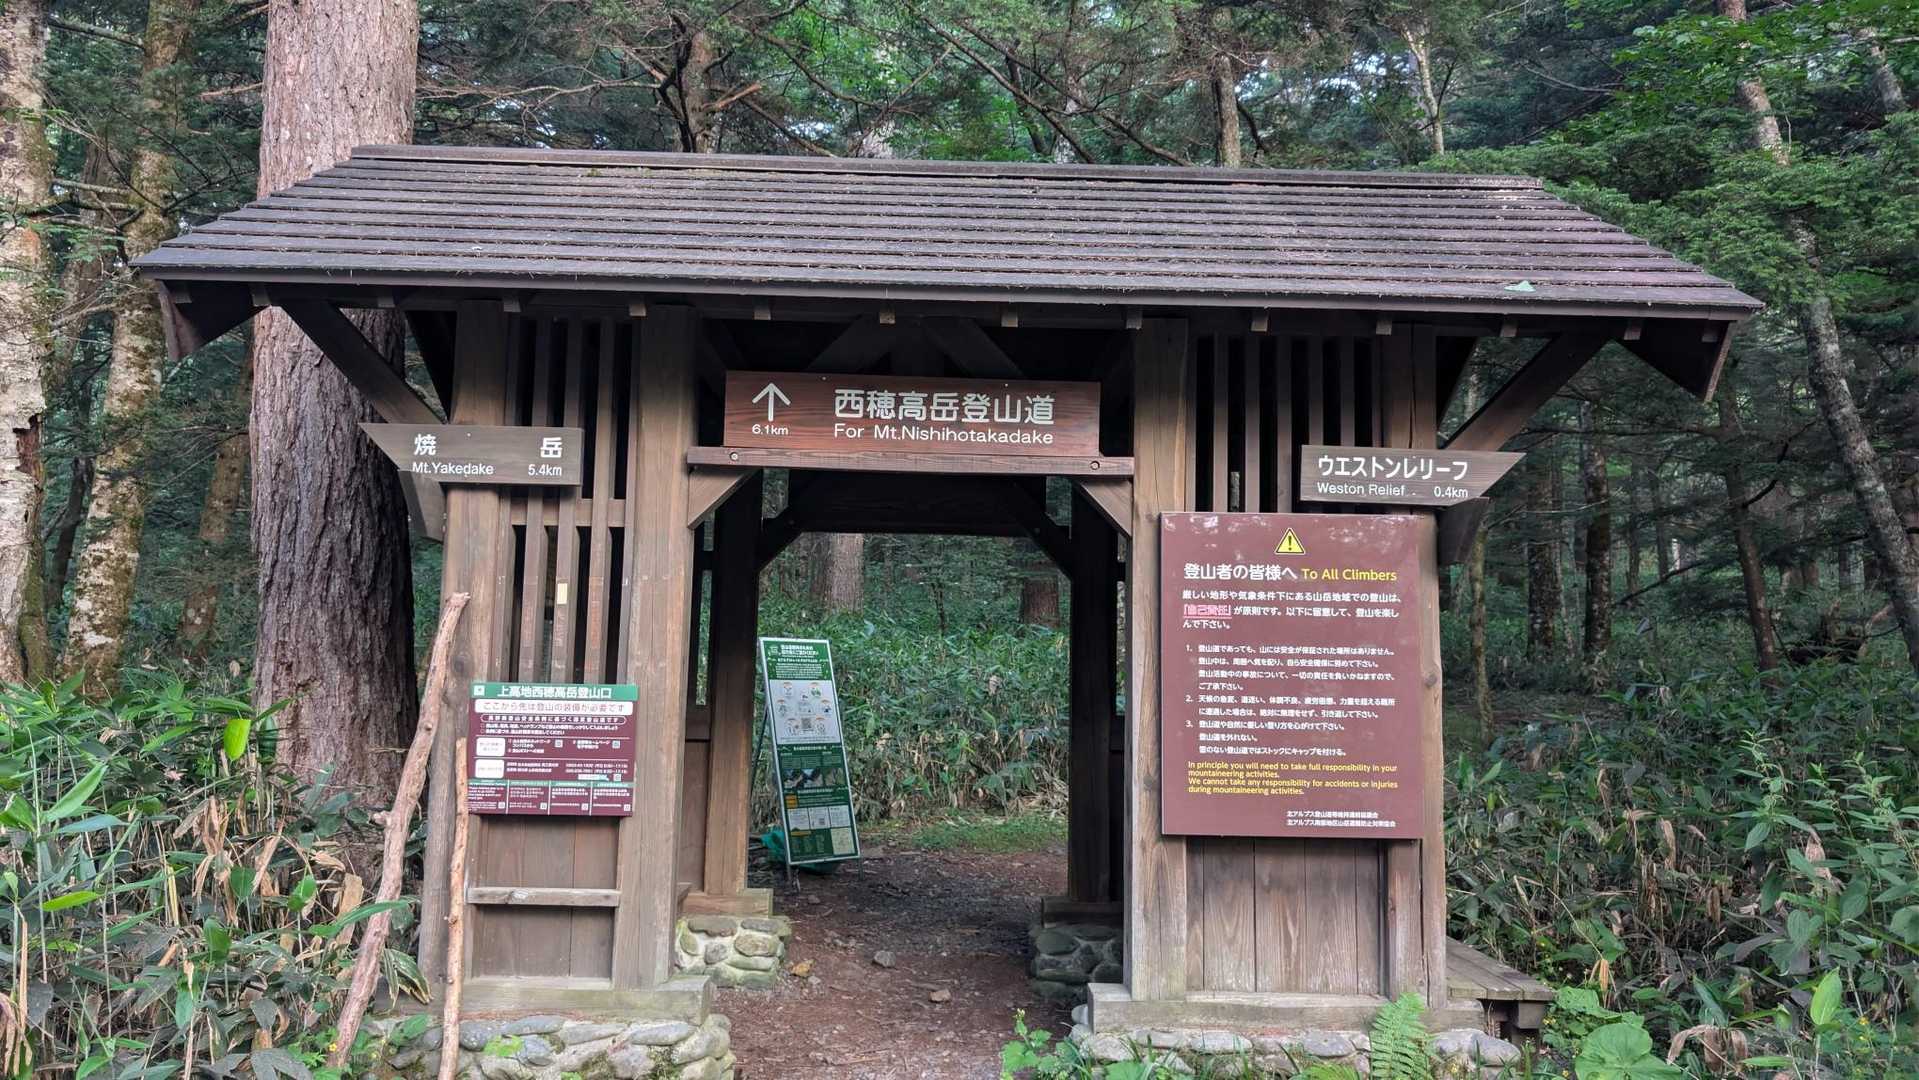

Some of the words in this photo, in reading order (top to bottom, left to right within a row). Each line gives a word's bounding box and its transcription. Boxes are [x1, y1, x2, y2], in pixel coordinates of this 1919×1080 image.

[834, 388, 1055, 425] 西穂高岳登山道
[751, 424, 789, 436] 6.1km
[834, 423, 864, 439] For
[874, 424, 1054, 444] Mt.Nishihotakadake
[414, 434, 436, 455] 焼
[540, 437, 562, 458] 岳
[412, 462, 494, 475] Mt.Yakedake
[528, 464, 562, 476] 5.4km
[1318, 455, 1468, 480] ウエストンレリーフ
[1318, 483, 1364, 494] Weston
[1369, 484, 1405, 495] Relief
[1434, 487, 1468, 497] 0.4km
[1184, 563, 1298, 580] 登山者の皆様へ
[1301, 568, 1317, 579] To
[1322, 569, 1337, 580] All
[1343, 569, 1397, 581] Climbers
[497, 686, 612, 699] 上高地西穂高岳登山口
[1197, 762, 1229, 770] principle
[1245, 762, 1259, 770] will
[1322, 764, 1371, 772] responsibility
[1381, 765, 1397, 773] your
[1188, 770, 1244, 779] mountaineering
[1245, 770, 1279, 778] activities.
[1229, 778, 1246, 786] take
[1247, 780, 1261, 788] any
[1262, 779, 1310, 788] responsibility
[1371, 780, 1398, 790] injuries
[1188, 786, 1211, 794] during
[1213, 786, 1269, 796] mountaineering
[1270, 787, 1304, 795] activities.
